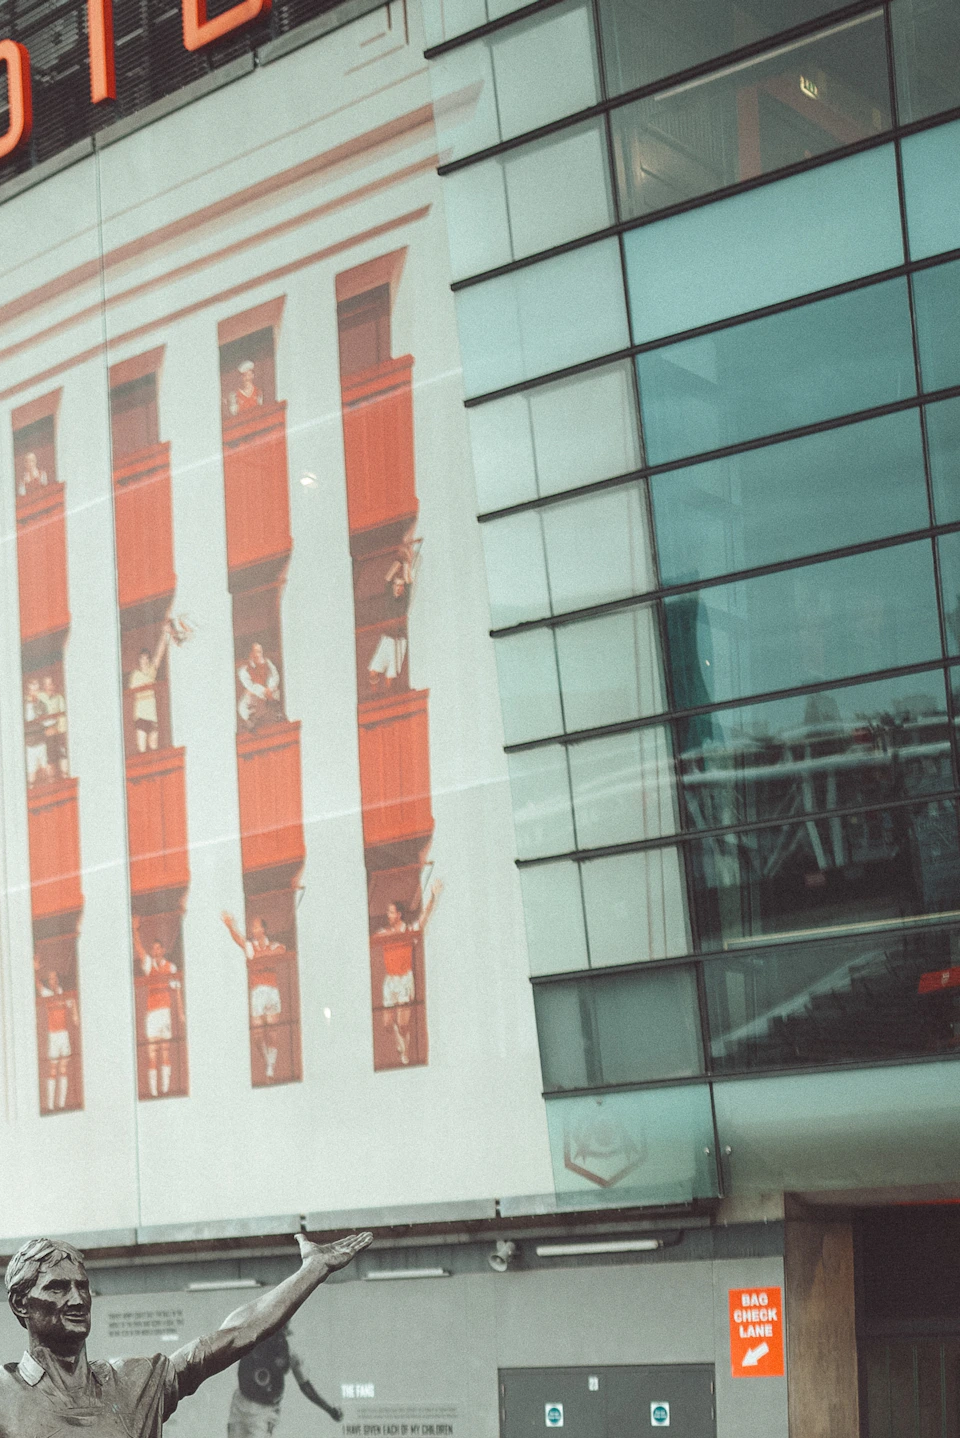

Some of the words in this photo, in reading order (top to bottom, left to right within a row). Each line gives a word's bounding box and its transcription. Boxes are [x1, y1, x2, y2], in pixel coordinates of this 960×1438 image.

[741, 1292, 769, 1307] BAG
[733, 1308, 778, 1323] CHECK
[739, 1324, 773, 1339] LANE
[341, 1384, 354, 1399] THE
[346, 1424, 361, 1436] HAVE
[363, 1424, 381, 1436] GIVEN
[383, 1424, 399, 1436] EACH
[401, 1424, 409, 1436] OF
[411, 1424, 420, 1436] MY
[422, 1424, 454, 1436] CHILDREN
